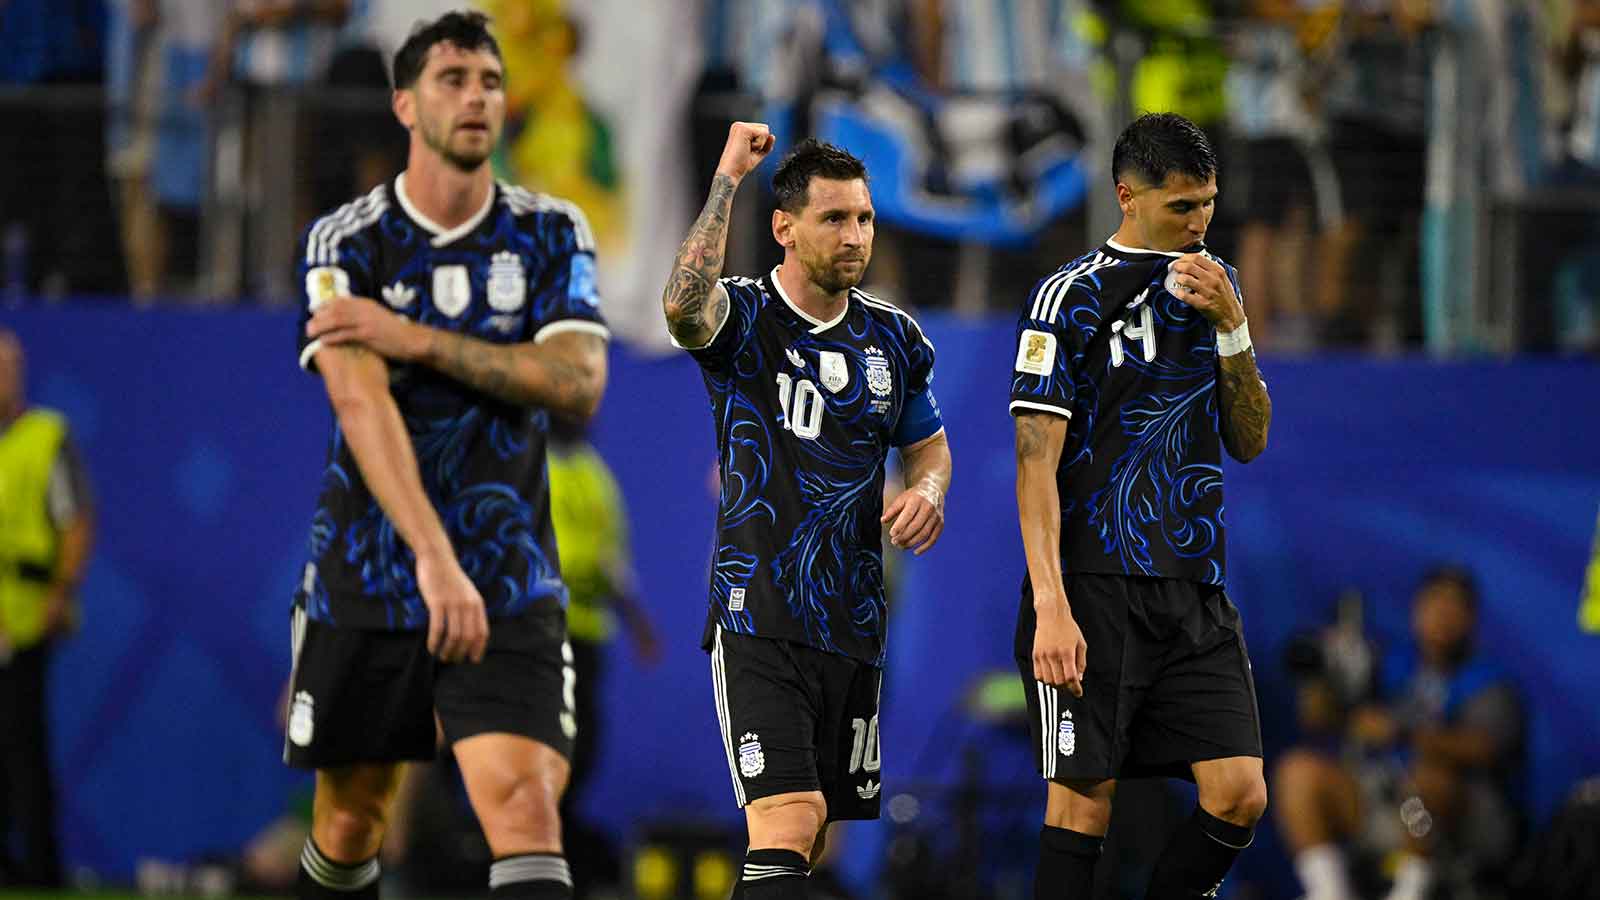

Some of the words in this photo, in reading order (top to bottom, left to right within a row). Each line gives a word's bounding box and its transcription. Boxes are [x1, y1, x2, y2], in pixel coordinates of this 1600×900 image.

[1109, 302, 1157, 368] 14
[776, 372, 825, 440] 10
[848, 714, 881, 775] 10
